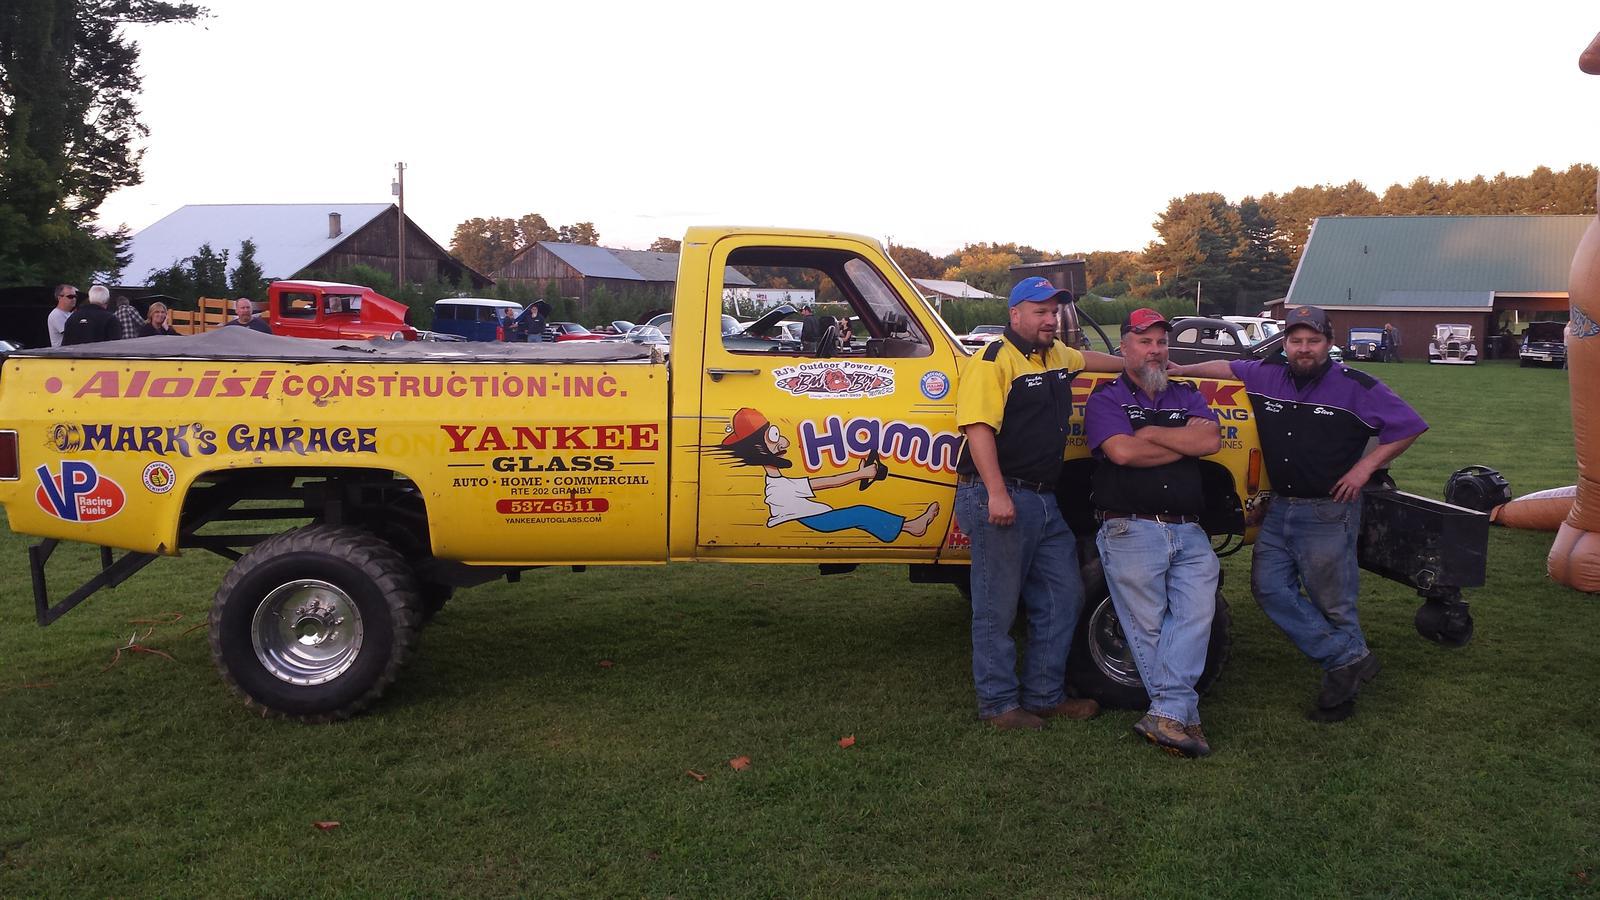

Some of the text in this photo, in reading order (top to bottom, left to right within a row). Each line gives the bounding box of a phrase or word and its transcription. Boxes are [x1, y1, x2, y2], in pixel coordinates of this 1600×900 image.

[800, 362, 840, 372] Outdoor
[844, 362, 874, 371] Power
[73, 370, 277, 398] Aloisi
[227, 423, 378, 456] GARAGE
[440, 423, 659, 453] YANKEE
[492, 456, 615, 472] GLASS
[452, 475, 649, 488] AUTO HOME COMMERCIAL
[36, 460, 98, 521] VP
[511, 486, 593, 496] RTE 202 GRANBY
[80, 496, 112, 508] Racing
[511, 500, 595, 512] 537-6511
[80, 506, 106, 516] Fuels
[505, 516, 602, 524] YANKEEAUTOGLASS.COM
